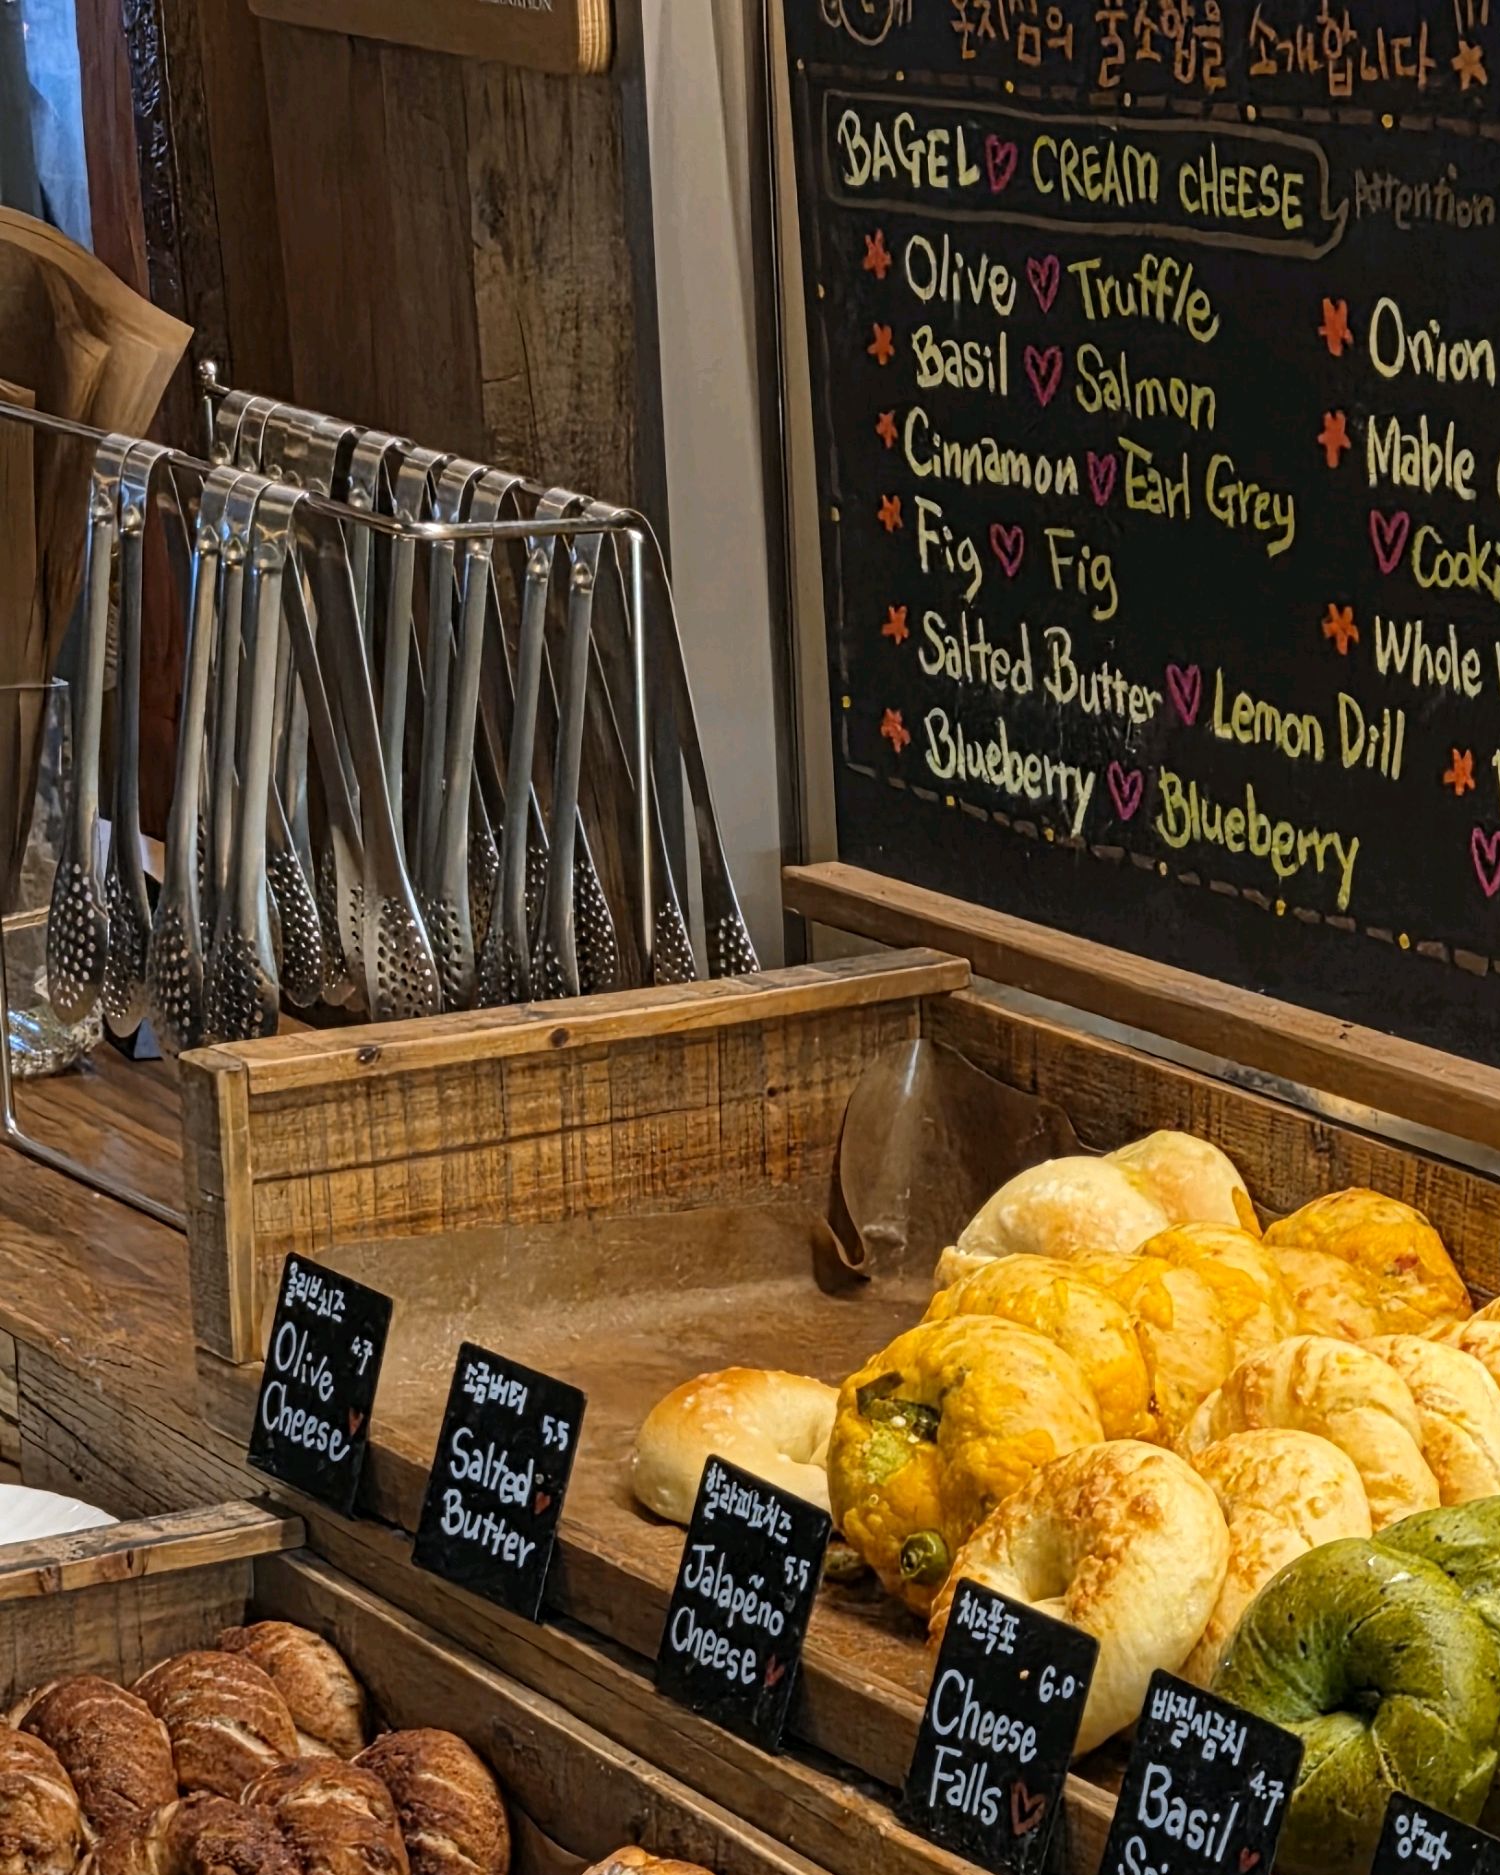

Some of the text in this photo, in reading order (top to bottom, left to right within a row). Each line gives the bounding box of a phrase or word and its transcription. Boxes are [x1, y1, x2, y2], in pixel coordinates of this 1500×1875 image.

[838, 109, 1305, 230] BAGEL CREAM CHEESE
[905, 233, 1220, 342] Olive Truffle
[912, 325, 1217, 431] Basil Salmon
[1368, 297, 1496, 387] Onion
[904, 406, 1296, 557] Cinnamon Earl Grey
[1366, 413, 1477, 500] Mable
[915, 496, 1119, 621] Fig Fig
[918, 610, 1406, 780] Salted Butter Lemon Dill
[1374, 615, 1483, 699] Whole
[924, 707, 1361, 911] Blueberry Blueberry
[284, 1261, 346, 1323] 올리브치즈
[274, 1321, 335, 1402] Olive
[463, 1361, 529, 1416] 소금버터
[262, 1380, 351, 1462] Cheese
[541, 1415, 570, 1451] 5.5
[450, 1426, 535, 1507] Salted
[703, 1461, 793, 1545] 할라피뇨치즈
[440, 1488, 536, 1569] Butter
[783, 1555, 811, 1593] 5.5
[671, 1605, 758, 1685] Cheese
[957, 1589, 1020, 1655] 치즈폭포
[931, 1668, 1039, 1764] Cheese
[1038, 1664, 1076, 1704] 6.0
[1151, 1687, 1248, 1767] 바질시금치
[929, 1744, 1002, 1826] Falls
[1137, 1761, 1241, 1863] Basil
[1250, 1769, 1286, 1827] 4.7
[1395, 1811, 1452, 1871] 양파
